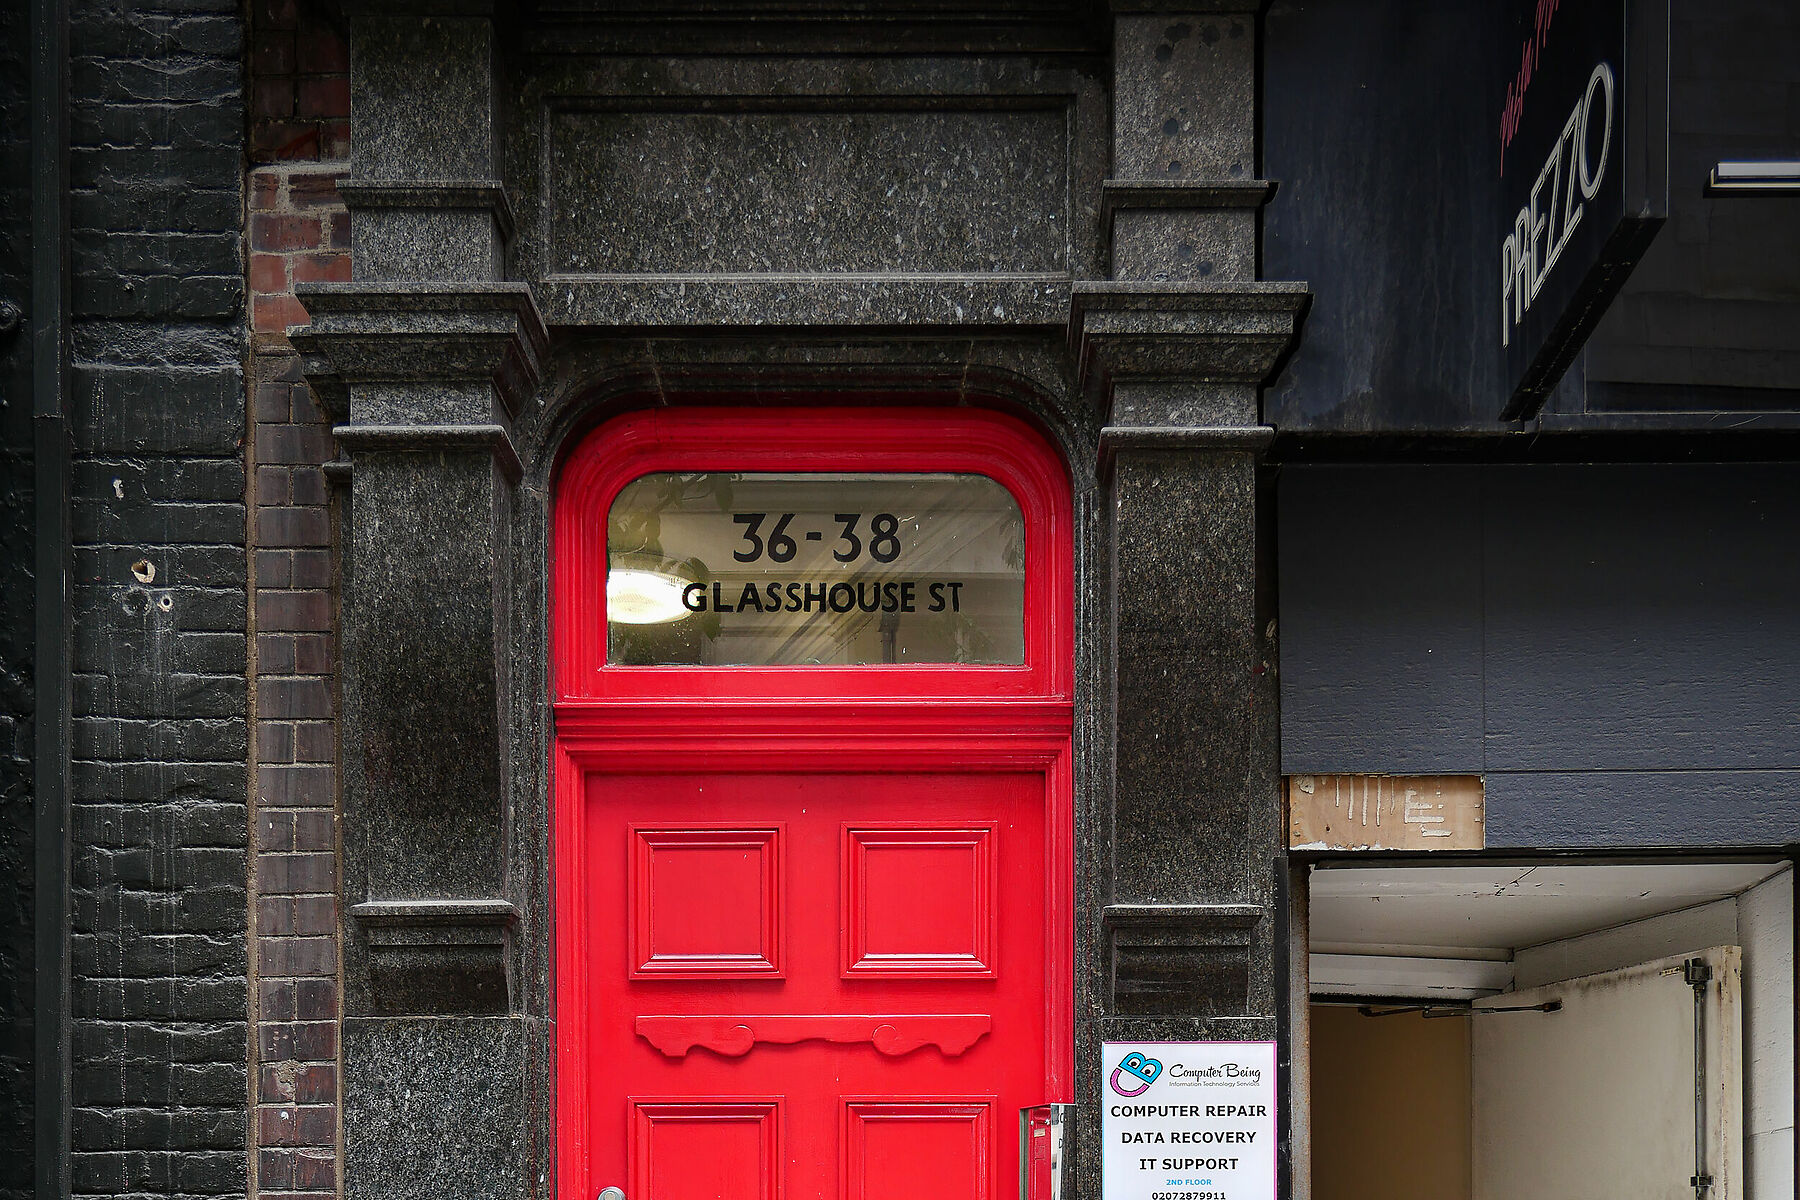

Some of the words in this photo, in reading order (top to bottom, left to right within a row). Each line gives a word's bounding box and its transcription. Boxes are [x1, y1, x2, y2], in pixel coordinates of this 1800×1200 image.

[1502, 62, 1614, 349] PREZZO
[733, 513, 901, 563] 36-38
[682, 582, 915, 613] GLASSHOUSE
[928, 582, 963, 612] ST
[1169, 1063, 1222, 1082] Computer
[1220, 1063, 1260, 1083] Being
[1110, 1105, 1200, 1117] COMPUTER
[1205, 1105, 1267, 1117] REPAIR
[1121, 1132, 1165, 1144] DATA
[1170, 1132, 1256, 1144] RECOVERY
[1139, 1158, 1157, 1170] IT
[1162, 1158, 1238, 1170] SUPPORT
[1152, 1192, 1226, 1200] 02072879911
